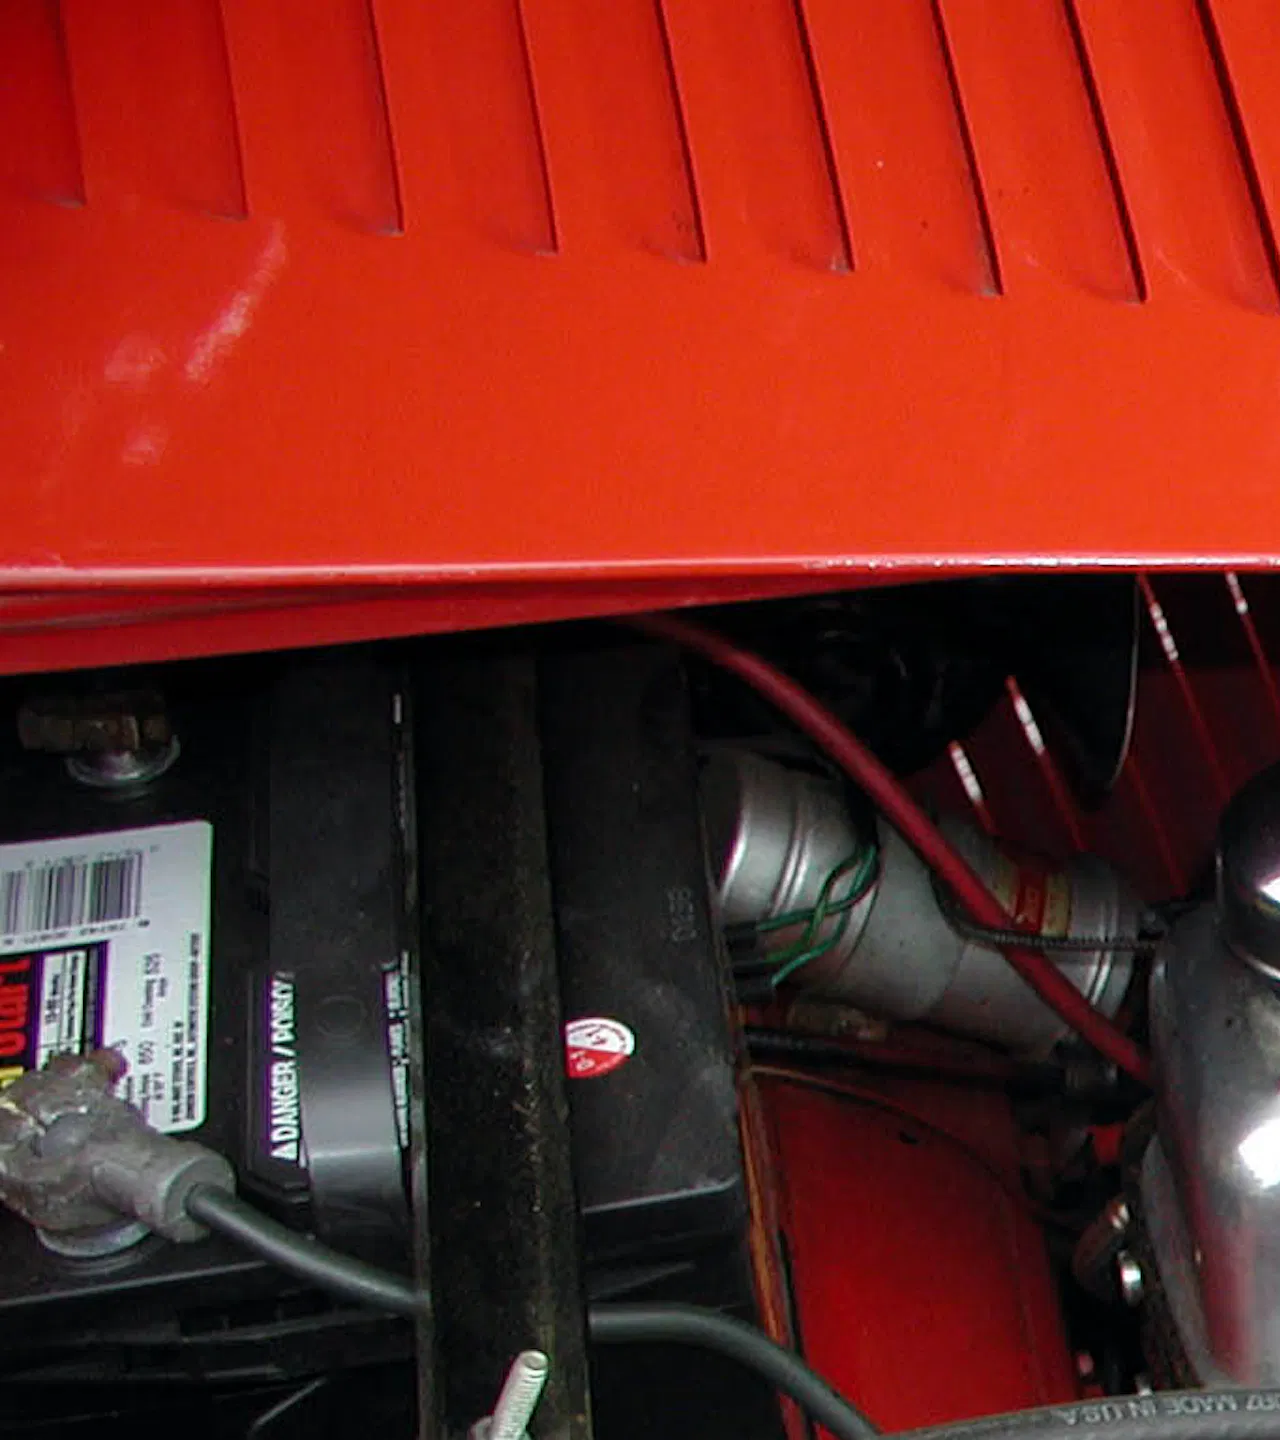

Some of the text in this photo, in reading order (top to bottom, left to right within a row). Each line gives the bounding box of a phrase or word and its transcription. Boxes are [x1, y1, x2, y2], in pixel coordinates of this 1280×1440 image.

[271, 1061, 299, 1142] DANGER
[1127, 1397, 1157, 1420] IN
[1166, 1394, 1238, 1416] MADE
